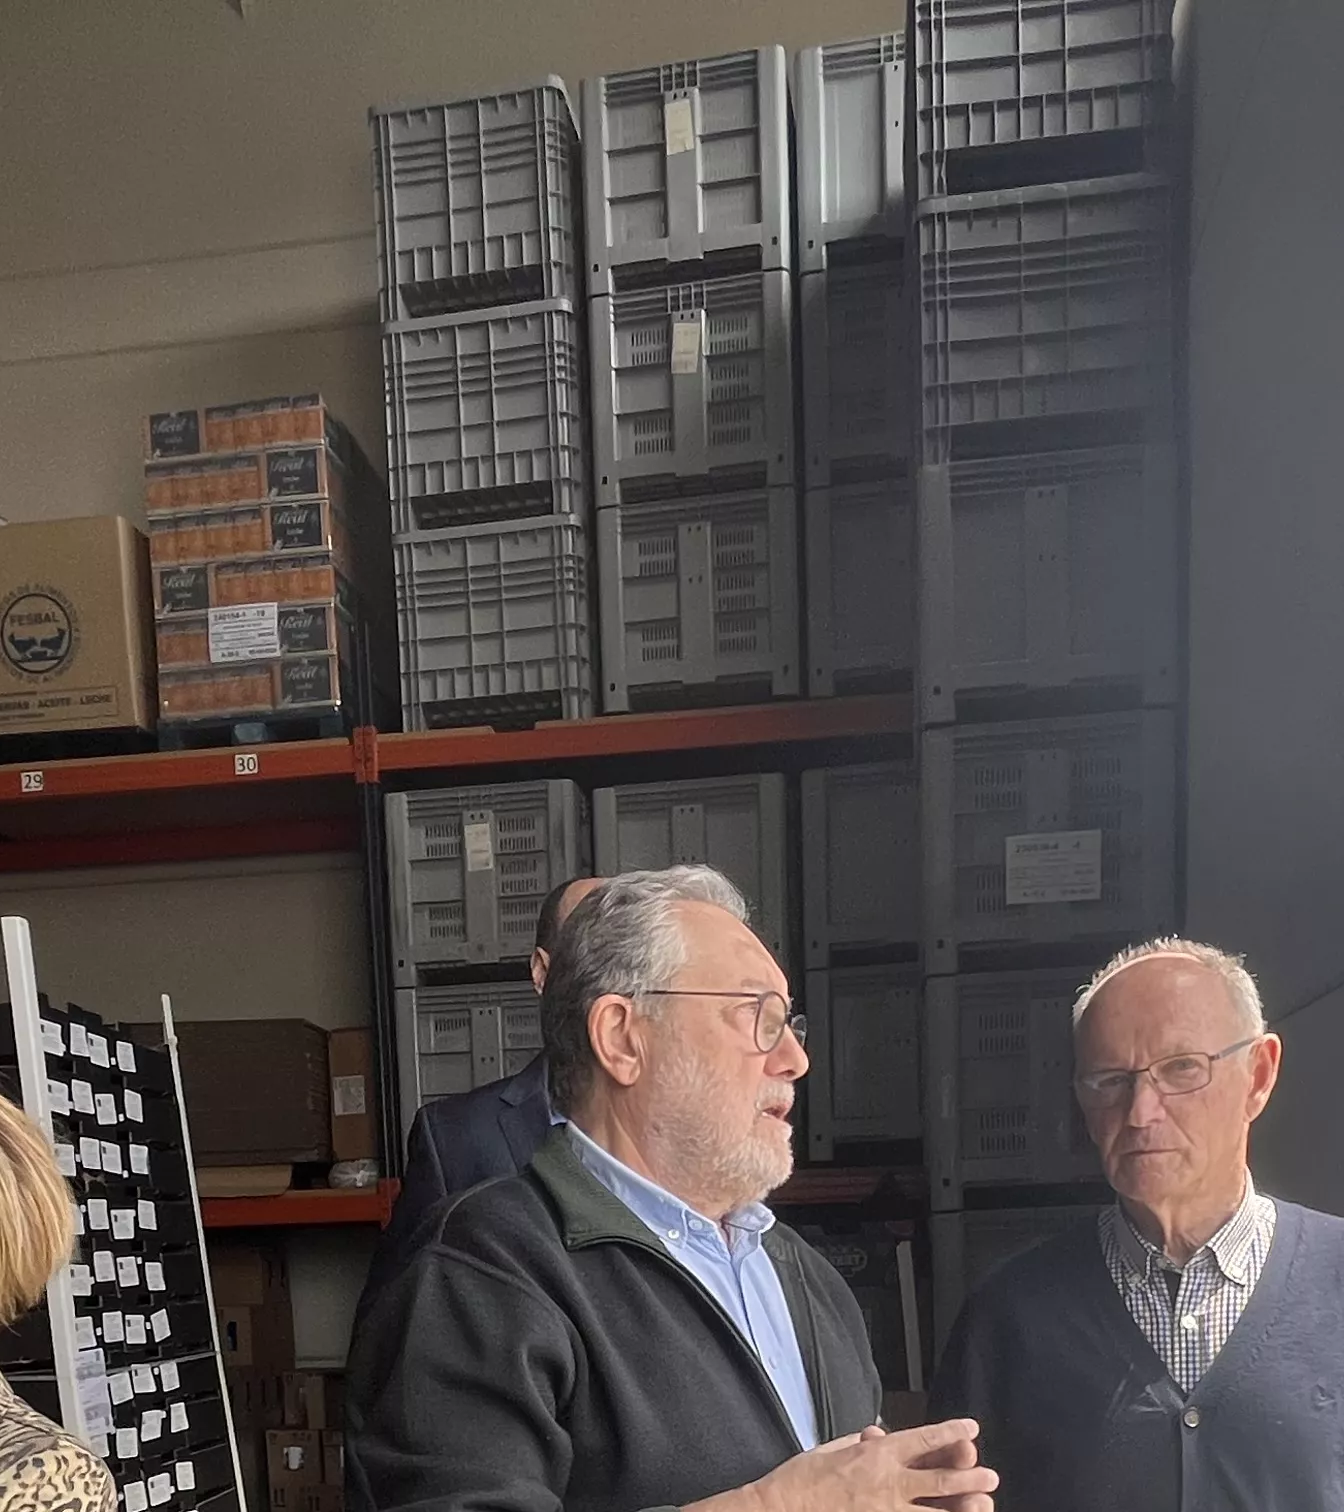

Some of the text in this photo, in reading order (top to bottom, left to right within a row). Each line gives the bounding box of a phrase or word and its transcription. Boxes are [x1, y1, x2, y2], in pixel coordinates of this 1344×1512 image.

[8, 610, 61, 627] FESBAL
[235, 755, 257, 773] 30
[22, 774, 43, 790] 29
